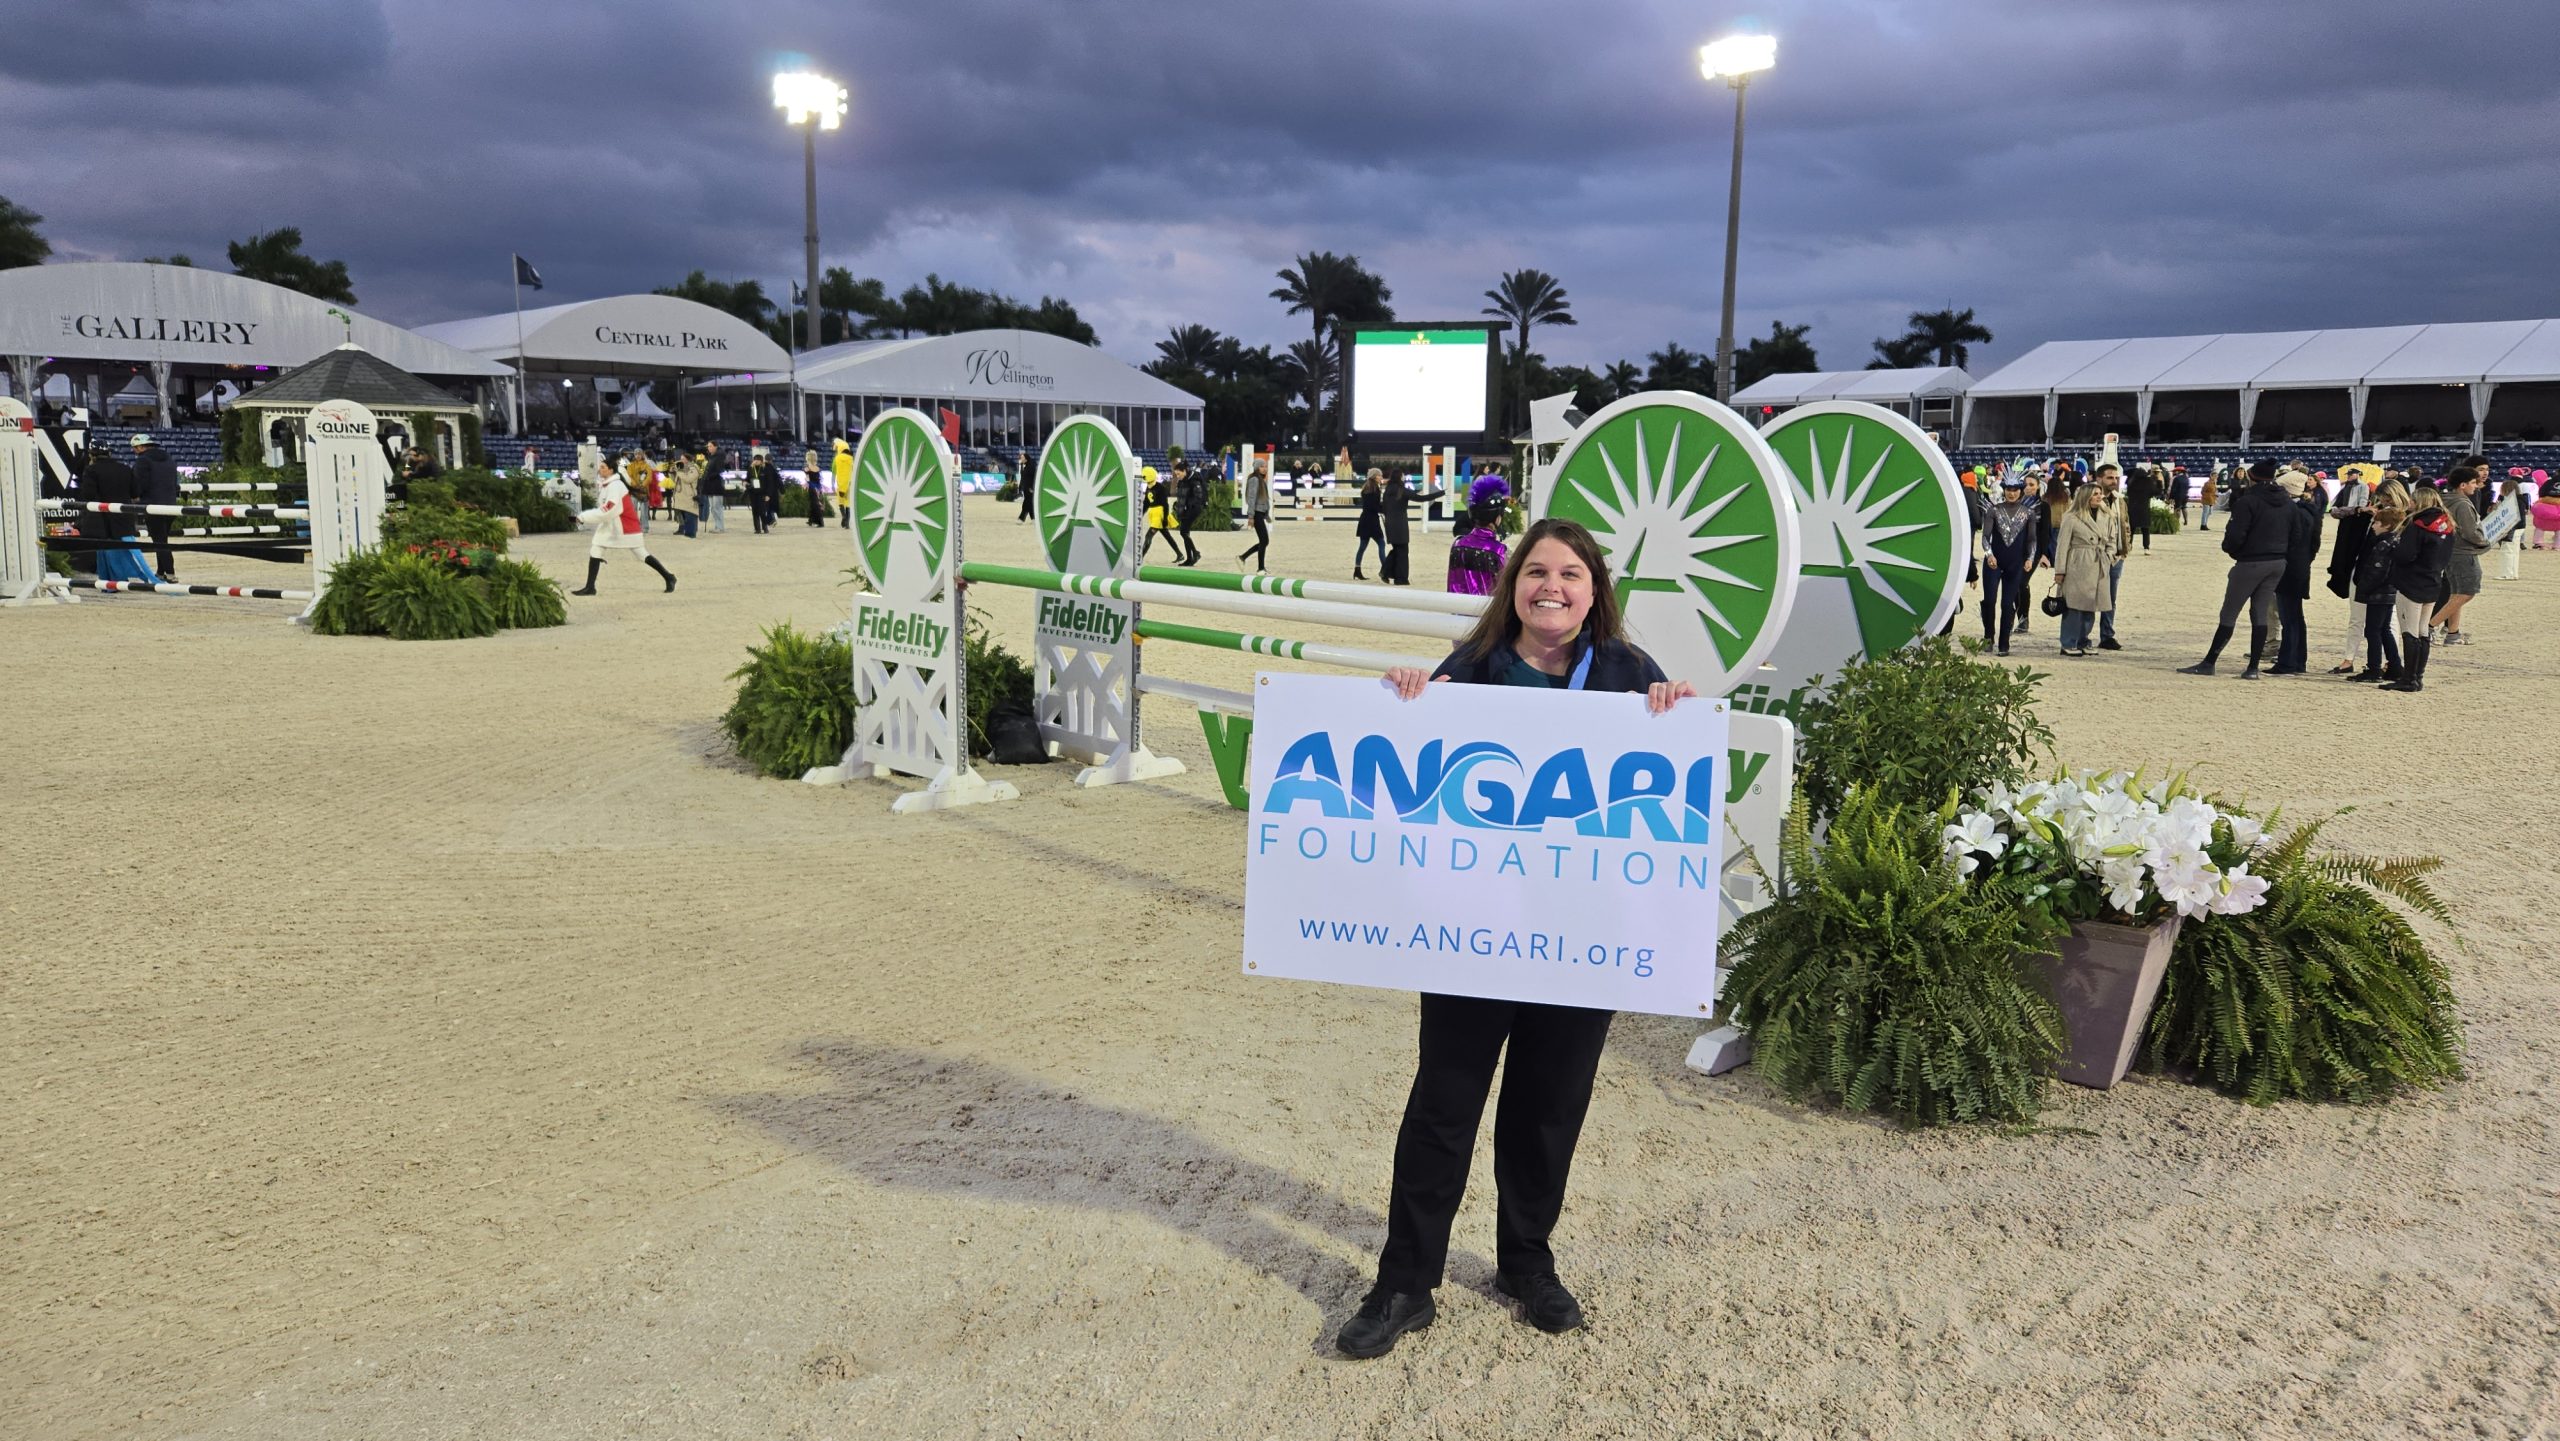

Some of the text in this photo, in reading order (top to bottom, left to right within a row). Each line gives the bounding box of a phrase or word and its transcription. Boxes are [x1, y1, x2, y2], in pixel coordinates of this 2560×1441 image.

[61, 314, 71, 336] THE
[75, 314, 259, 345] GALLERY
[966, 350, 1054, 389] Wellington
[857, 605, 950, 658] Fidelity
[1038, 627, 1108, 644] INVESTMENTS
[1039, 596, 1128, 645] Fidelity
[856, 639, 929, 657] INVESTMENTS
[1263, 731, 1713, 845] ANGARI
[1259, 823, 1709, 890] FOUNDATION
[1299, 918, 1656, 978] www.ANGARI.org
